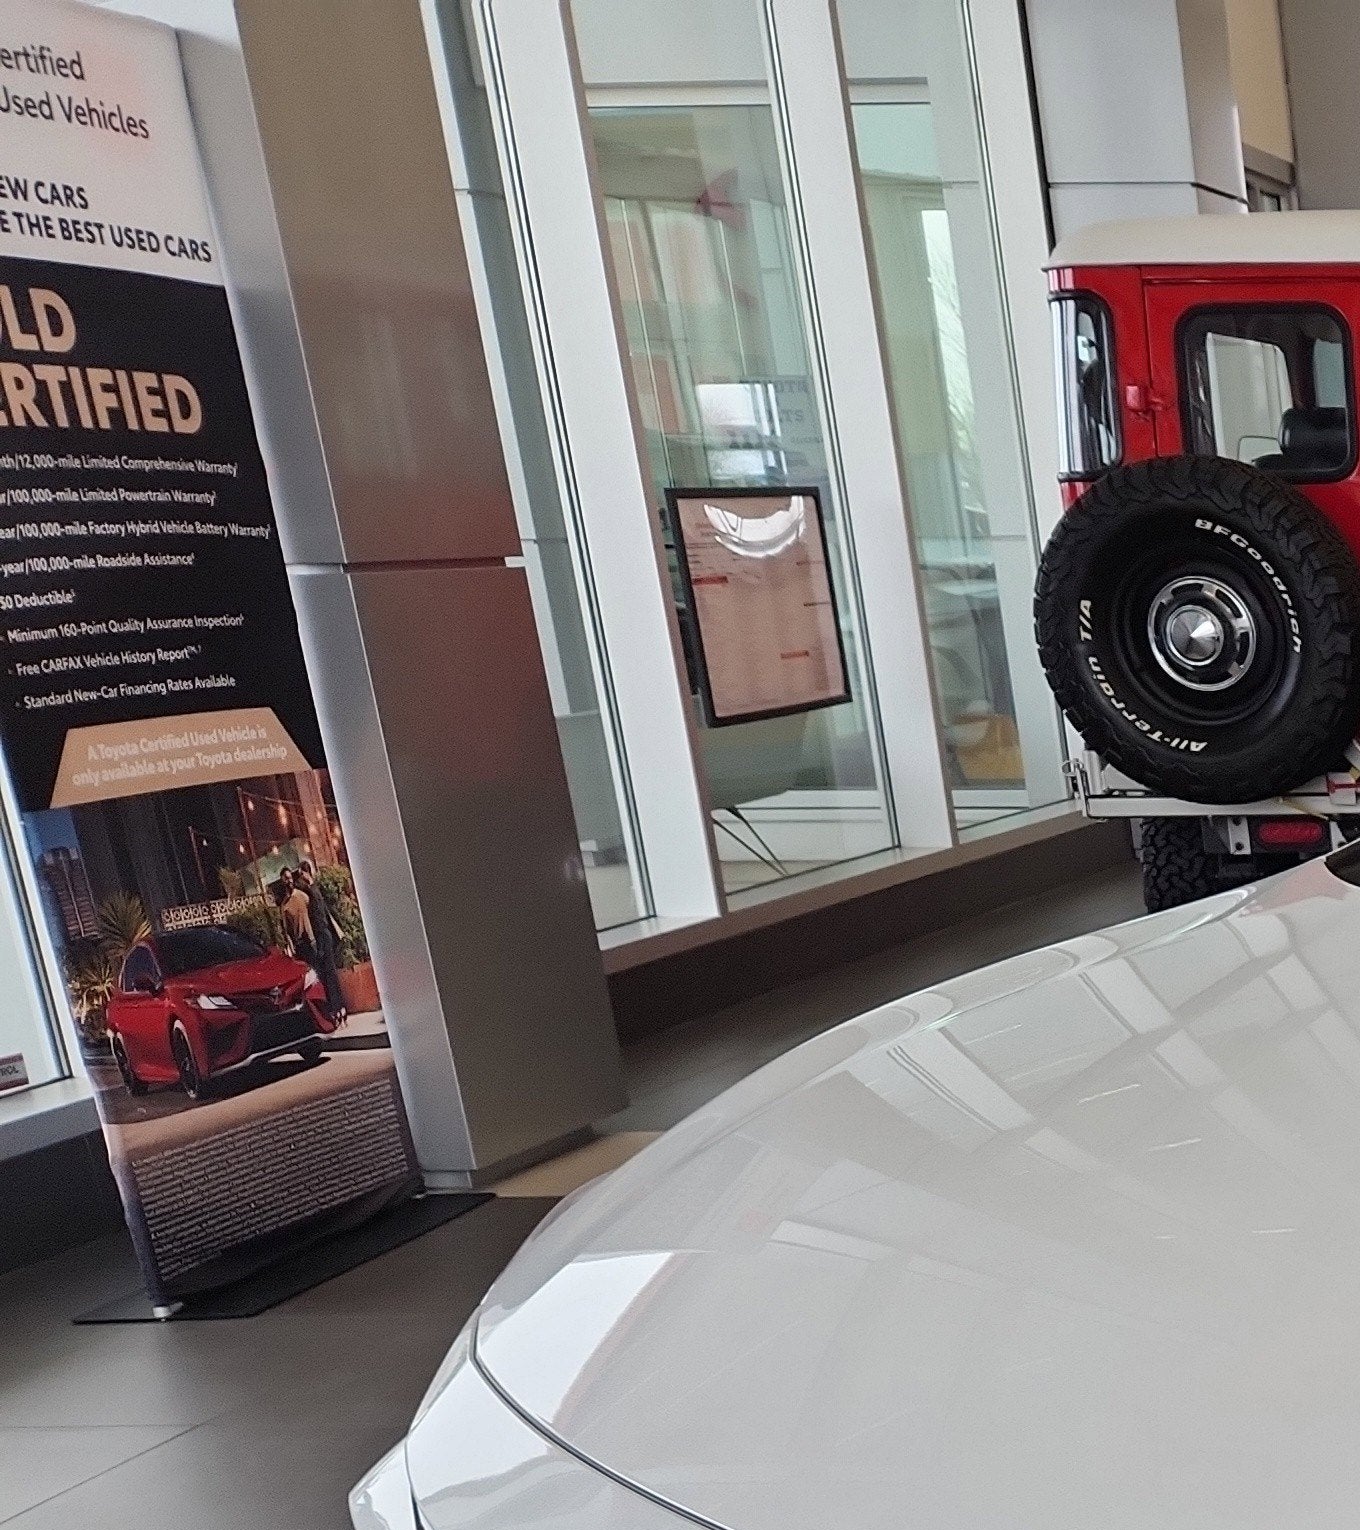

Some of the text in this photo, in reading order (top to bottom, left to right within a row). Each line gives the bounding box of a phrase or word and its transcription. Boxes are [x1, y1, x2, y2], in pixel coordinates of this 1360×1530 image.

[56, 94, 150, 139] Vehicles
[34, 181, 89, 210] CARS
[12, 211, 56, 240] THE
[58, 217, 105, 246] BEST
[109, 224, 160, 254] USED
[164, 235, 212, 263] CARS
[0, 284, 77, 353] LD
[0, 361, 203, 434] RTIFIED
[81, 454, 121, 469] Limited
[121, 455, 196, 473] Comprehensive
[79, 487, 119, 502] Limited
[118, 487, 172, 502] Powertrain
[88, 520, 125, 537] Factory
[126, 519, 160, 537] Hybrid
[159, 519, 195, 534] Vehicle
[194, 520, 228, 539] Battery
[96, 551, 143, 568] Roadside
[1194, 517, 1303, 654] BFGoodrich
[7, 627, 59, 643] Minimum
[58, 621, 108, 639] 160-Point
[108, 618, 144, 634] Quality
[146, 617, 194, 631] Assurance
[15, 662, 41, 677] Free
[41, 656, 84, 674] CARFAX
[83, 651, 121, 669] Vehicle
[120, 649, 156, 665] History
[1078, 599, 1209, 752] All-Terrain T/A
[23, 673, 236, 709] Standard New-Car Financing Rates Available
[87, 744, 98, 761] A
[97, 741, 140, 761] Toyota
[140, 733, 189, 753] Certified
[189, 730, 218, 747] Used
[217, 725, 258, 742] Vehicle
[72, 742, 288, 787] only available at your Toyota dealership
